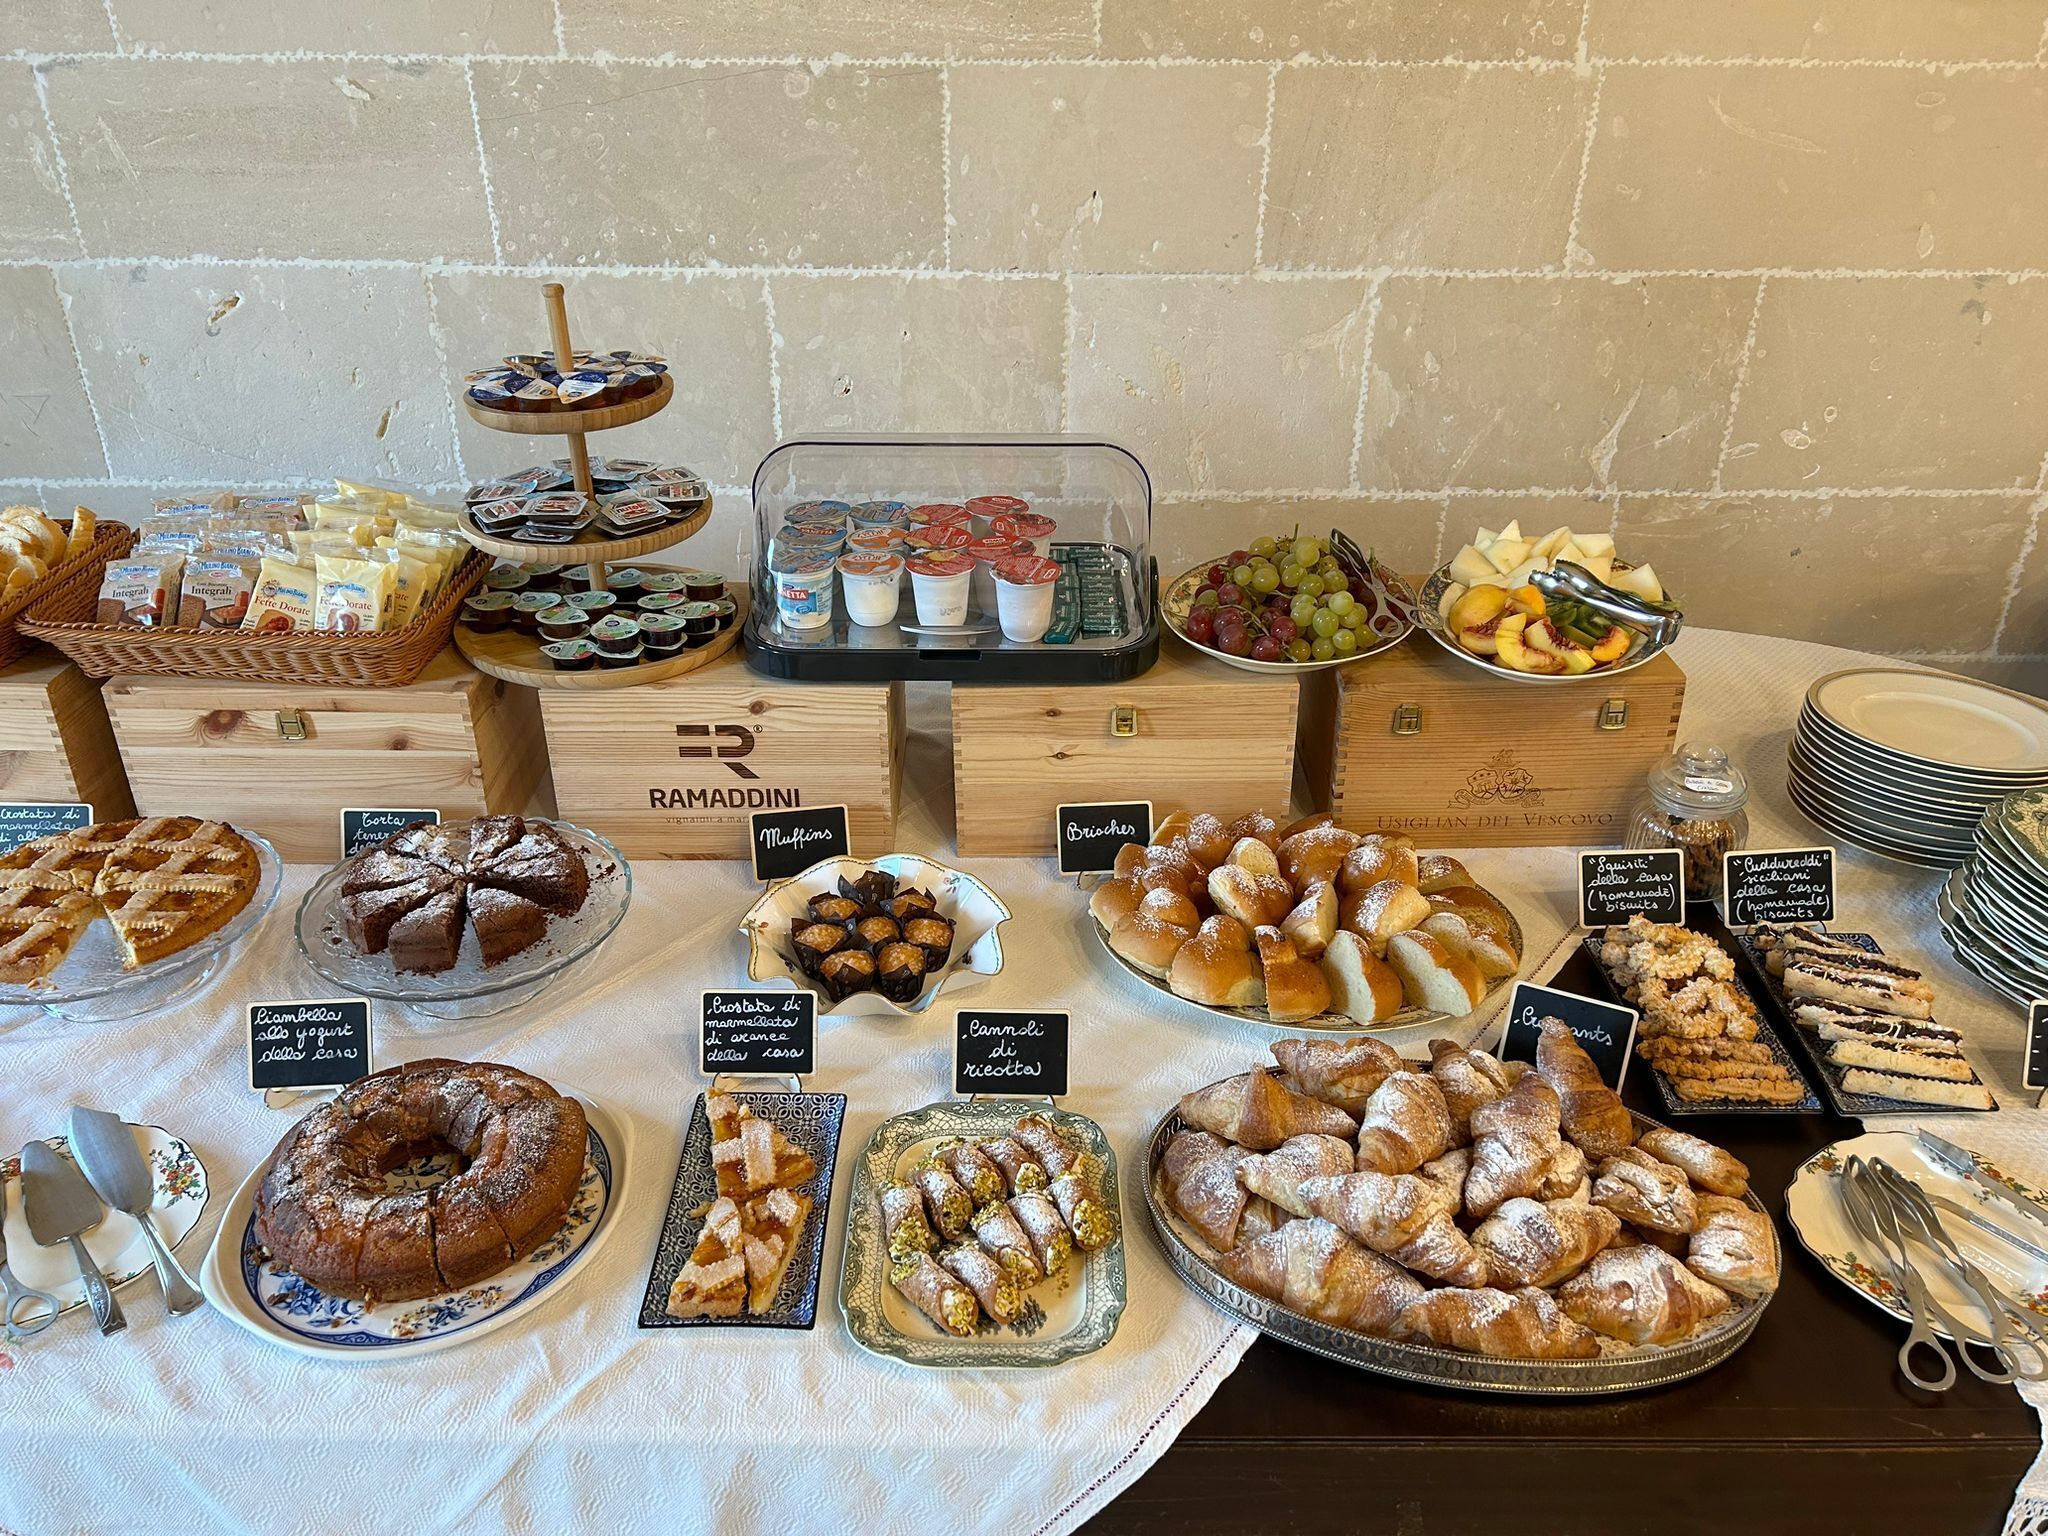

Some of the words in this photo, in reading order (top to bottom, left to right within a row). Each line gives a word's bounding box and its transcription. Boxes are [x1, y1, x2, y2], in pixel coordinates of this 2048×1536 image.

[112, 586, 149, 599] Integrali
[191, 585, 232, 597] Integrali
[254, 595, 277, 608] Fette
[279, 601, 311, 615] Dorate
[649, 788, 801, 808] RAMADDINI
[62, 807, 80, 819] di
[362, 812, 406, 828] Torta
[1377, 815, 1468, 829] USIGLIAN
[1523, 812, 1613, 827] VESCOVO
[353, 828, 396, 841] tener
[760, 827, 833, 850] Muffins
[1066, 819, 1136, 842] Brioches
[1587, 873, 1629, 888] della
[1635, 872, 1673, 883] casa
[1740, 869, 1810, 884] siciliani
[1733, 884, 1778, 899] della
[1786, 883, 1826, 894] casa
[707, 996, 775, 1015] Crostata
[782, 995, 802, 1011] di
[254, 1007, 342, 1025] Ciambella
[705, 1016, 799, 1028] marmellata
[962, 1019, 1045, 1039] Cannoli
[1514, 1006, 1613, 1046] Crants
[255, 1025, 290, 1041] allo
[296, 1023, 354, 1050] yogurt
[705, 1031, 722, 1046] di
[730, 1033, 791, 1043] arance
[257, 1046, 307, 1063] della
[311, 1048, 358, 1061] casa
[707, 1049, 748, 1062] della
[762, 1048, 805, 1058] casa
[988, 1038, 1017, 1059] di
[963, 1059, 1042, 1078] ricotta
